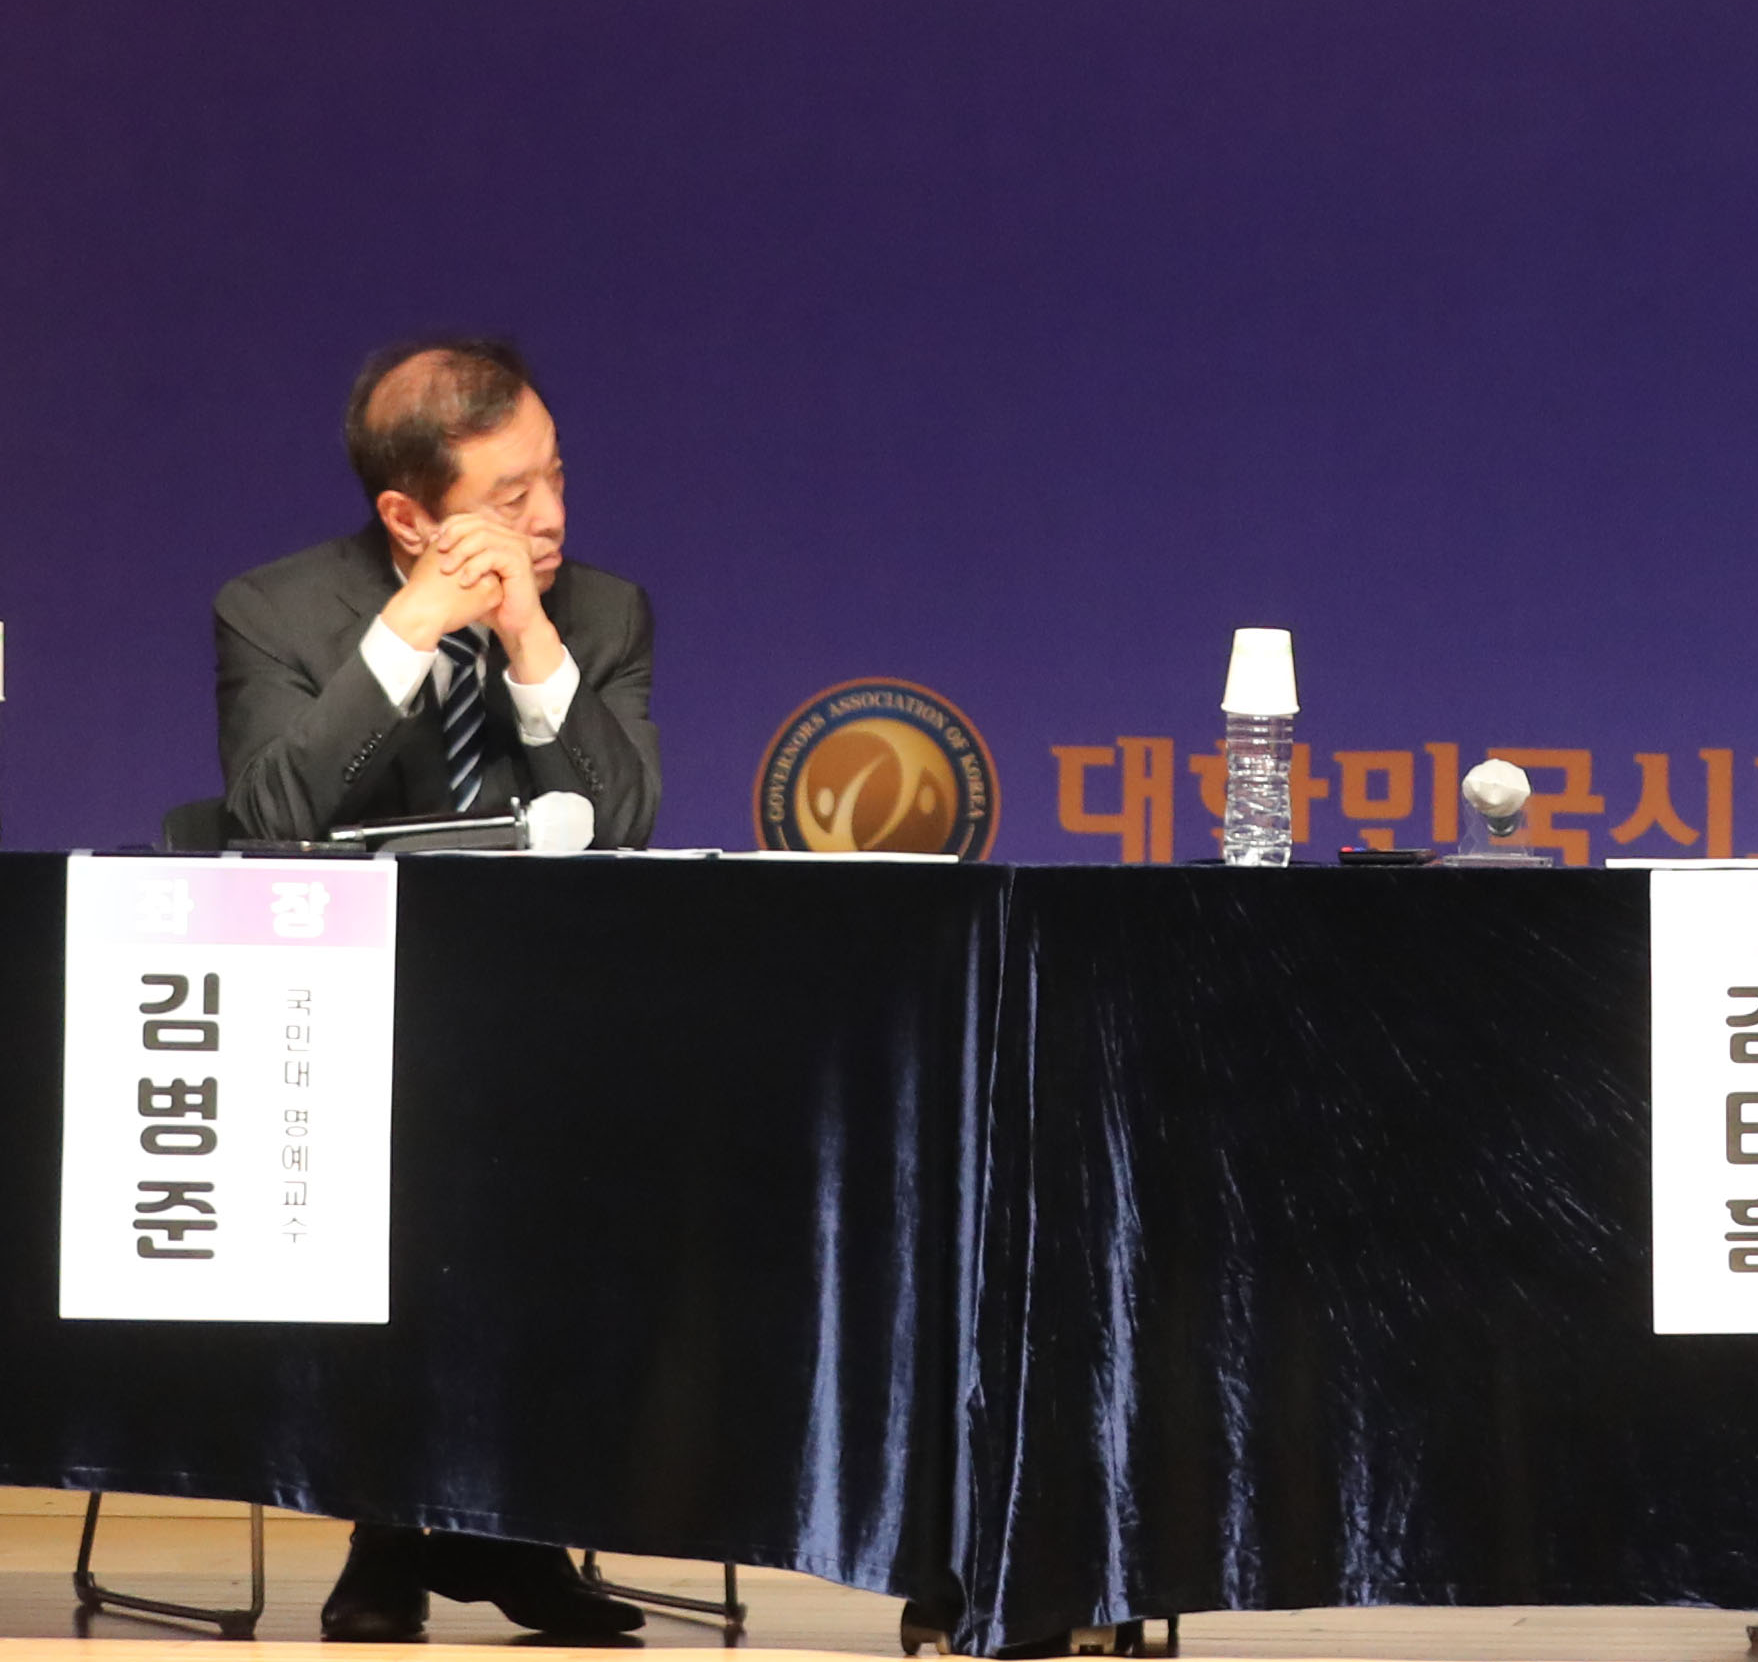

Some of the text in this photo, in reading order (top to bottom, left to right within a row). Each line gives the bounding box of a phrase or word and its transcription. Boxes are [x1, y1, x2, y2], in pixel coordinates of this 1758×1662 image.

[767, 690, 986, 823] GOVERNORS ASSOCIATION OF KOREA
[281, 988, 312, 1243] 국민대 명예교수
